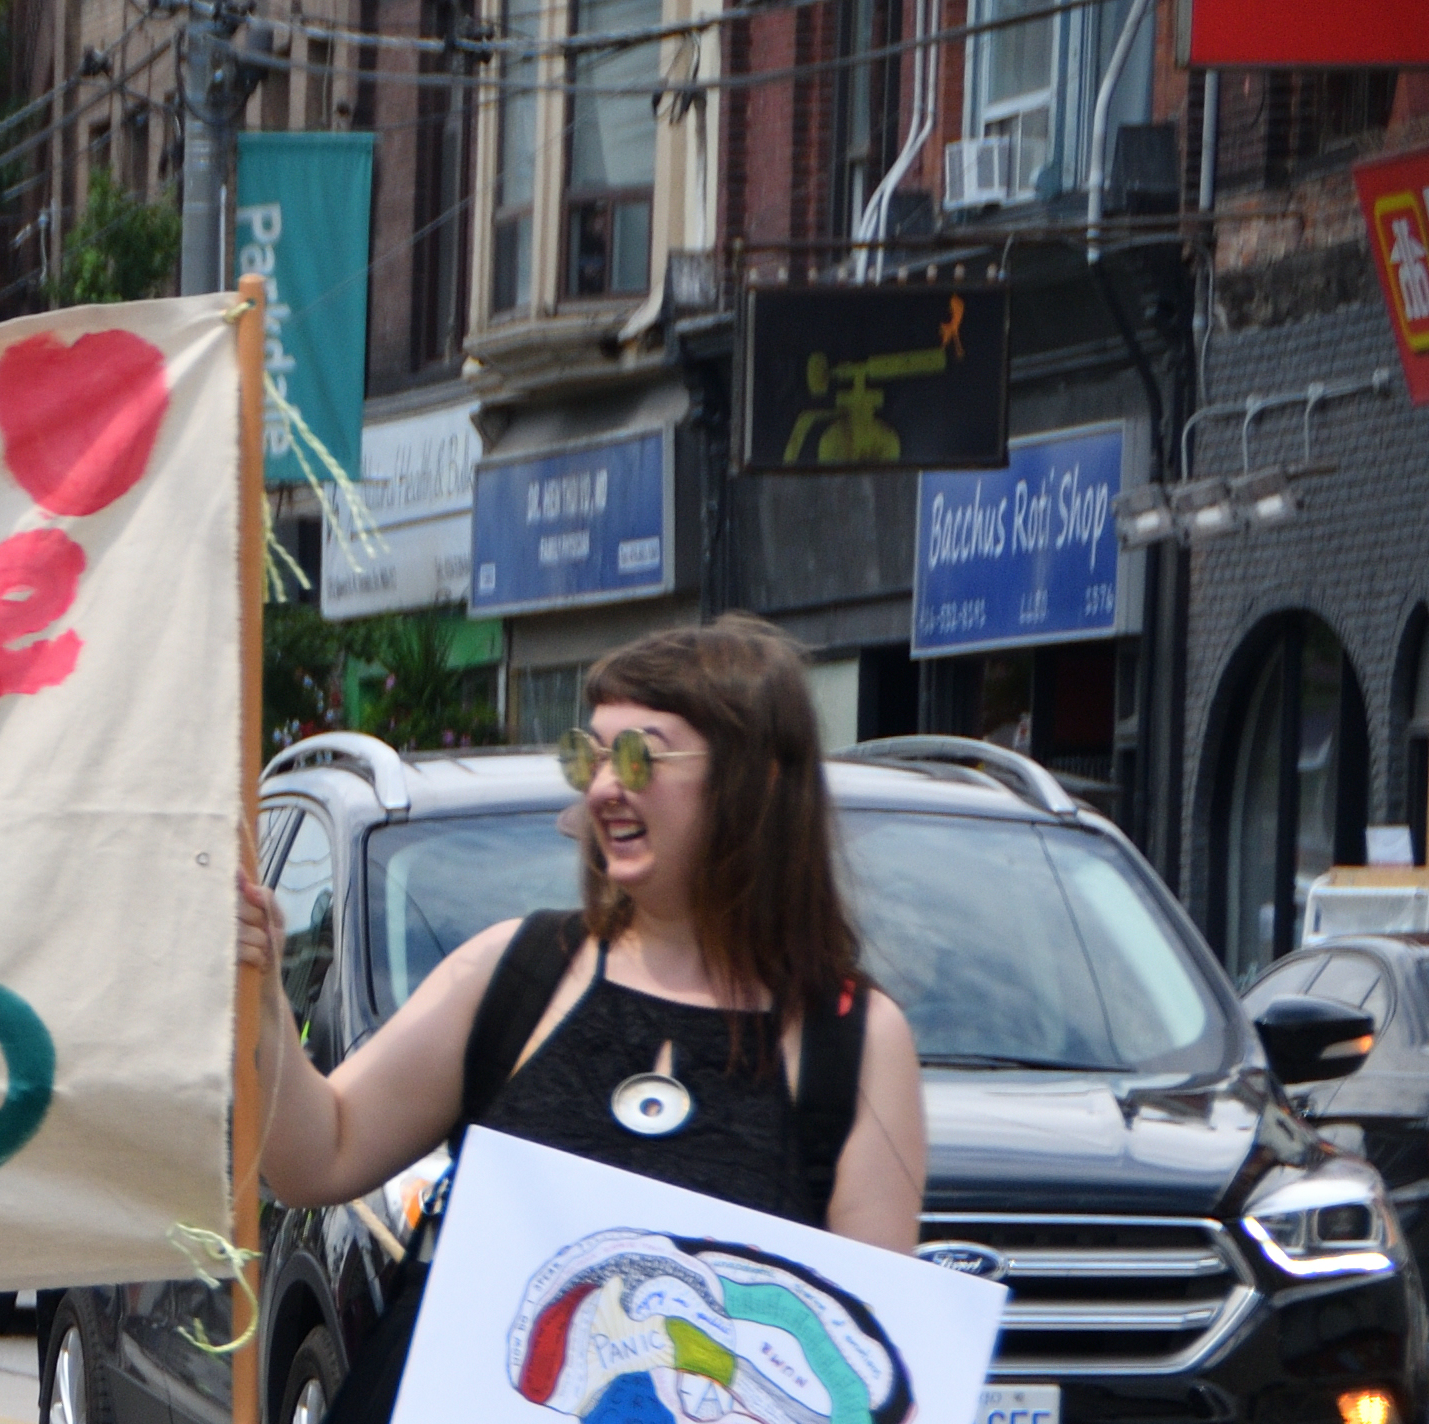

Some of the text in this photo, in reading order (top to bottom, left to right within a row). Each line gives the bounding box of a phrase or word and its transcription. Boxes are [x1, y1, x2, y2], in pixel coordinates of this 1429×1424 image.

[928, 460, 1108, 573] Bacchus Roti Shop
[593, 1331, 667, 1369] PANIC
